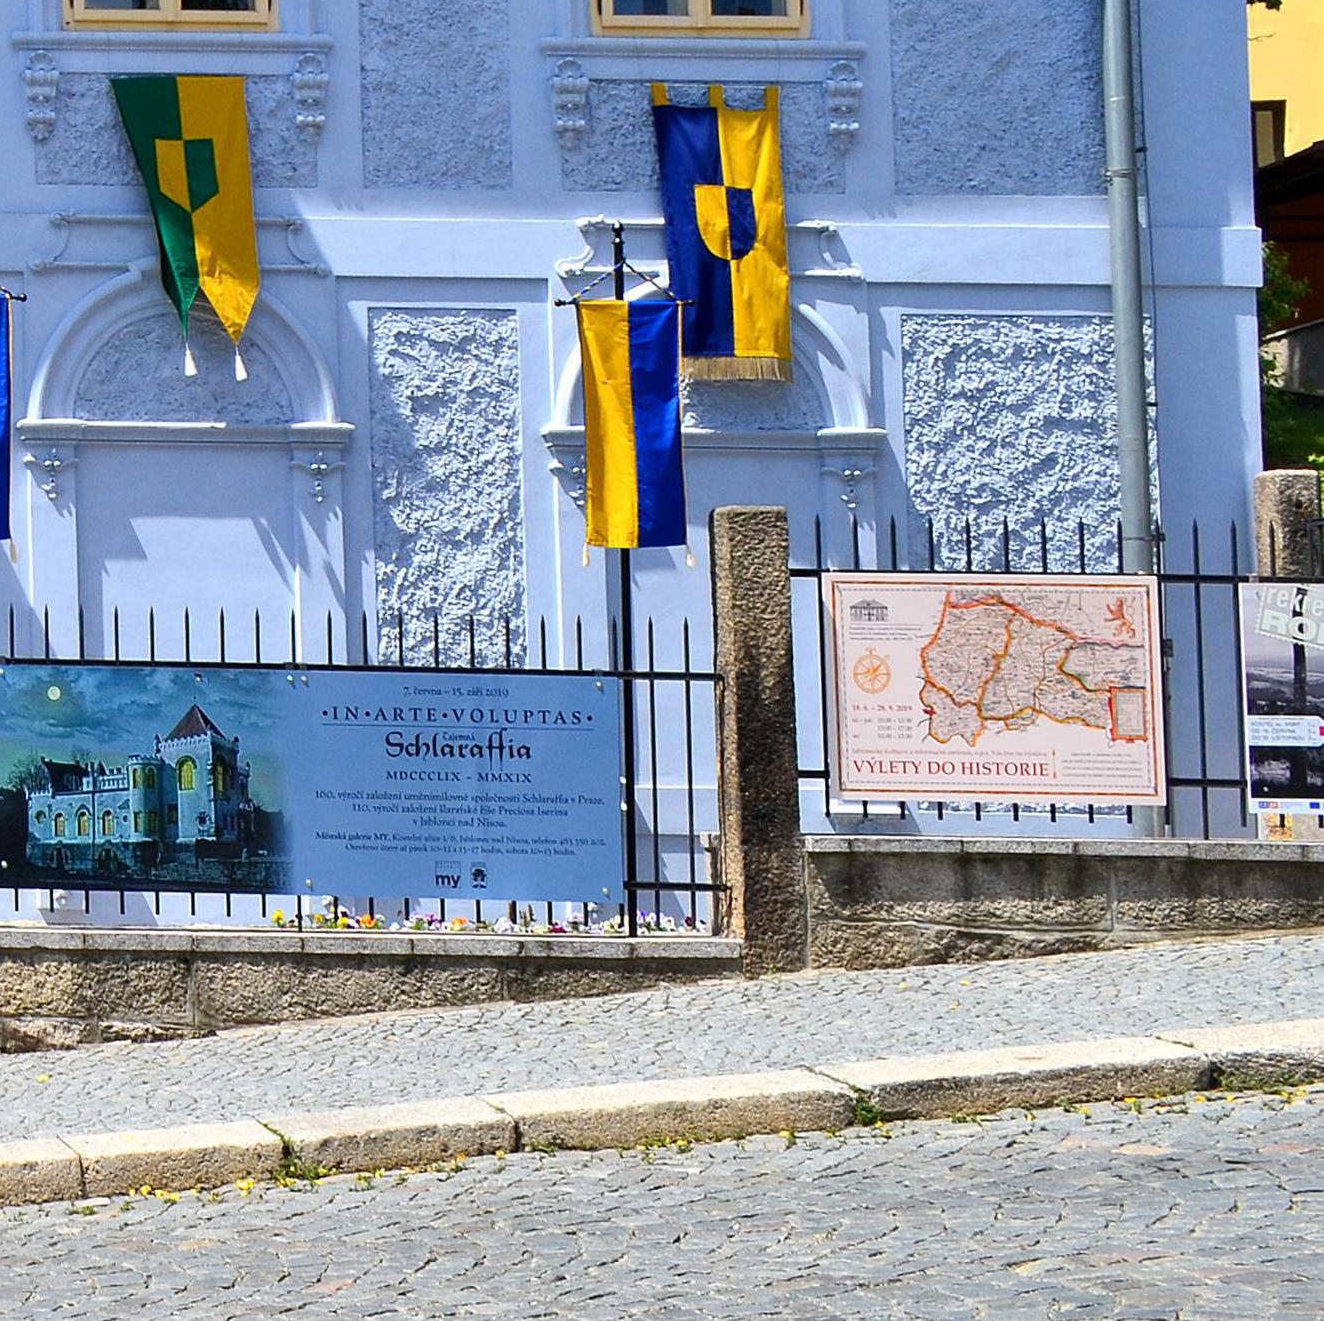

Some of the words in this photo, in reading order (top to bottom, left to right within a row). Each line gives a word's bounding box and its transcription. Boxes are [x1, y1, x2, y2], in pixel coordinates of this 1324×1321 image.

[385, 727, 532, 771] Schlaraffia
[852, 757, 922, 774] VÝLETY
[928, 761, 955, 775] DO
[961, 761, 1050, 777] HISTORIE
[386, 770, 461, 782] MDCCCLIX
[477, 772, 533, 784] MMXIX
[435, 874, 461, 889] my
